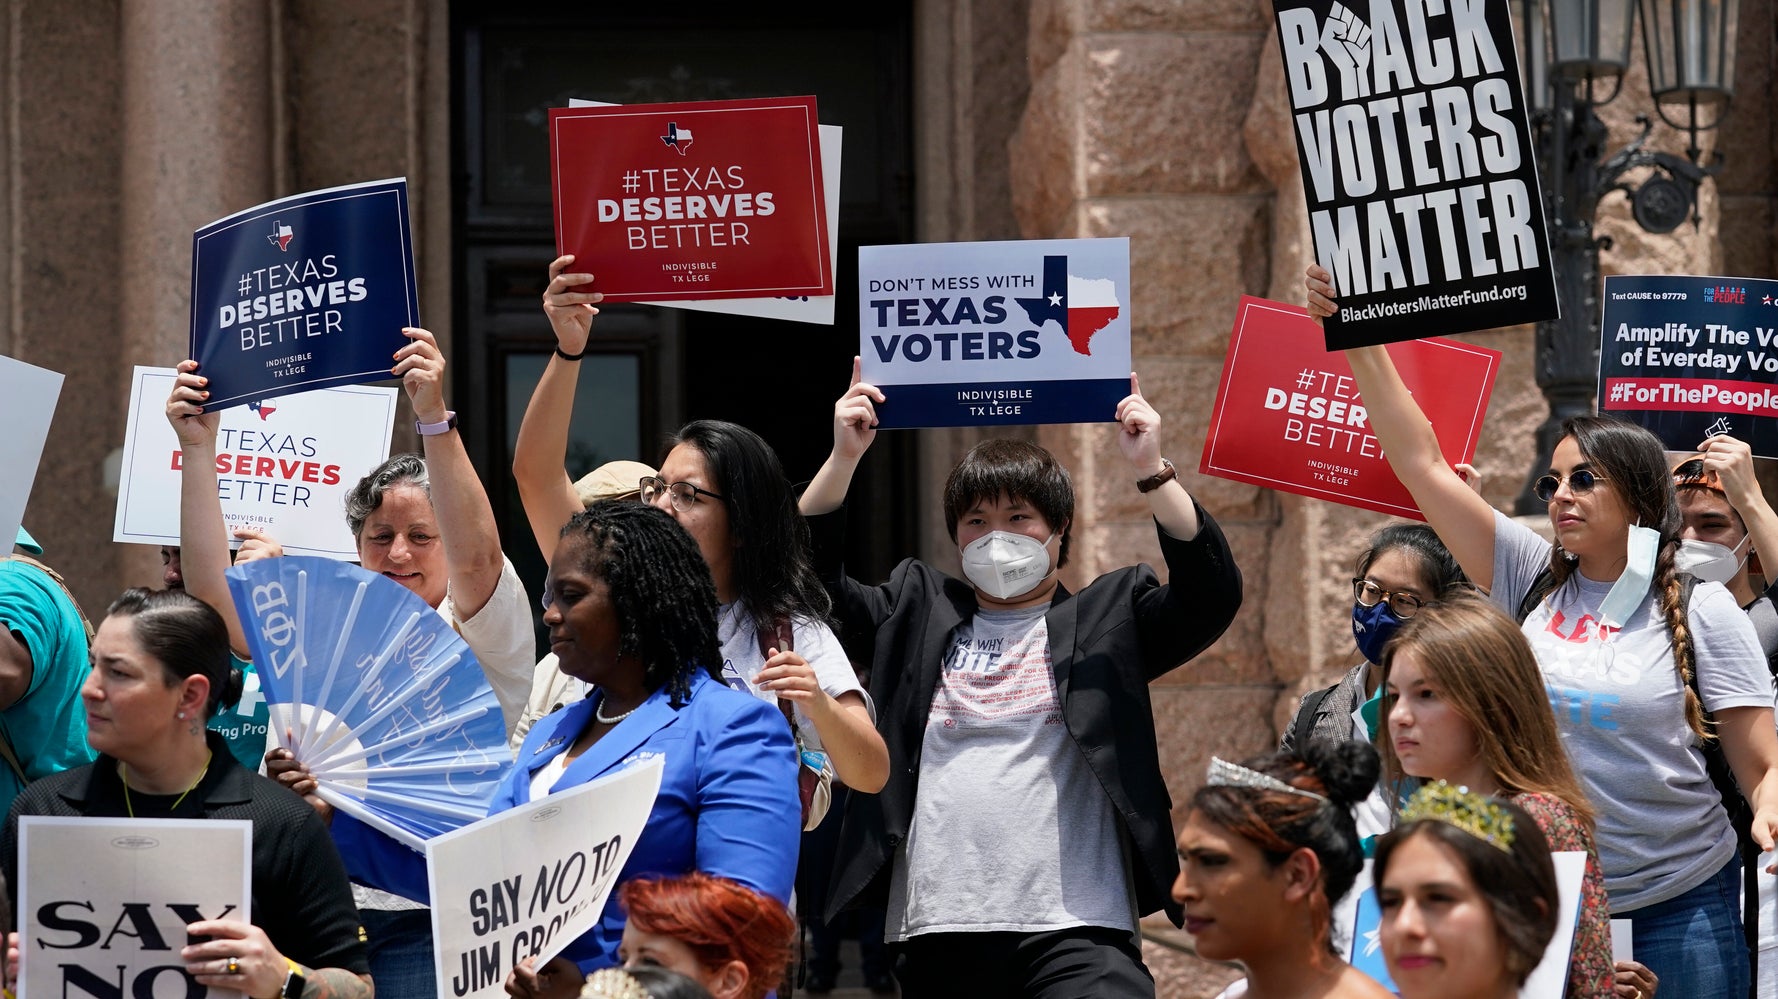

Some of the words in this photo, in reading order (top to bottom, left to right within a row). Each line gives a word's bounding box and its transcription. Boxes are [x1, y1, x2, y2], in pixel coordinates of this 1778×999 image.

[1296, 78, 1521, 203] VOTERS
[622, 165, 745, 194] #TEXAS
[597, 192, 776, 223] DESERVES
[627, 222, 750, 250] BETTER
[1311, 179, 1540, 298] MATTER
[238, 254, 338, 296] #TEXAS
[662, 262, 717, 271] INDIVISIBLE
[672, 275, 684, 283] TX
[686, 274, 710, 282] LEGE
[869, 278, 926, 292] DON'T
[932, 276, 980, 290] MESS
[986, 275, 1035, 288] WITH
[1612, 292, 1626, 300] Text
[1627, 292, 1652, 300] CAUSE
[1662, 292, 1687, 300] 97779
[1703, 287, 1715, 295] FOR
[1713, 291, 1745, 305] PEOPLE
[219, 277, 368, 329] DESERVES
[870, 295, 1008, 328] TEXAS
[1341, 284, 1527, 323] BlackVotersMatterFund.org
[241, 310, 343, 351] BETTER
[1615, 323, 1700, 347] Amplify
[1705, 324, 1750, 345] The
[265, 352, 312, 368] INDIVISIBLE
[871, 330, 1042, 363] VOTERS
[1621, 347, 1642, 366] of
[1646, 348, 1741, 373] Everday
[273, 370, 284, 378] TX
[285, 365, 306, 376] LEGE
[957, 389, 1033, 401] INDIVISIBLE
[1264, 387, 1368, 429] DESER
[969, 406, 985, 416] TX
[989, 405, 1021, 415] LEGE
[220, 428, 317, 457] TEXAS
[171, 450, 341, 486] DSERVES
[1307, 460, 1359, 477] INDIVISIBLE
[1313, 472, 1324, 481] TX
[1326, 476, 1349, 486] LEGE
[218, 479, 311, 508] ETTER
[222, 513, 274, 524] NDIVISIBLE
[977, 638, 1004, 651] WHY
[470, 874, 522, 937] SAY
[528, 851, 586, 919] NO
[592, 834, 622, 886] TO
[36, 900, 237, 951] SAY
[57, 963, 208, 999] NO
[453, 941, 500, 997] JIM
